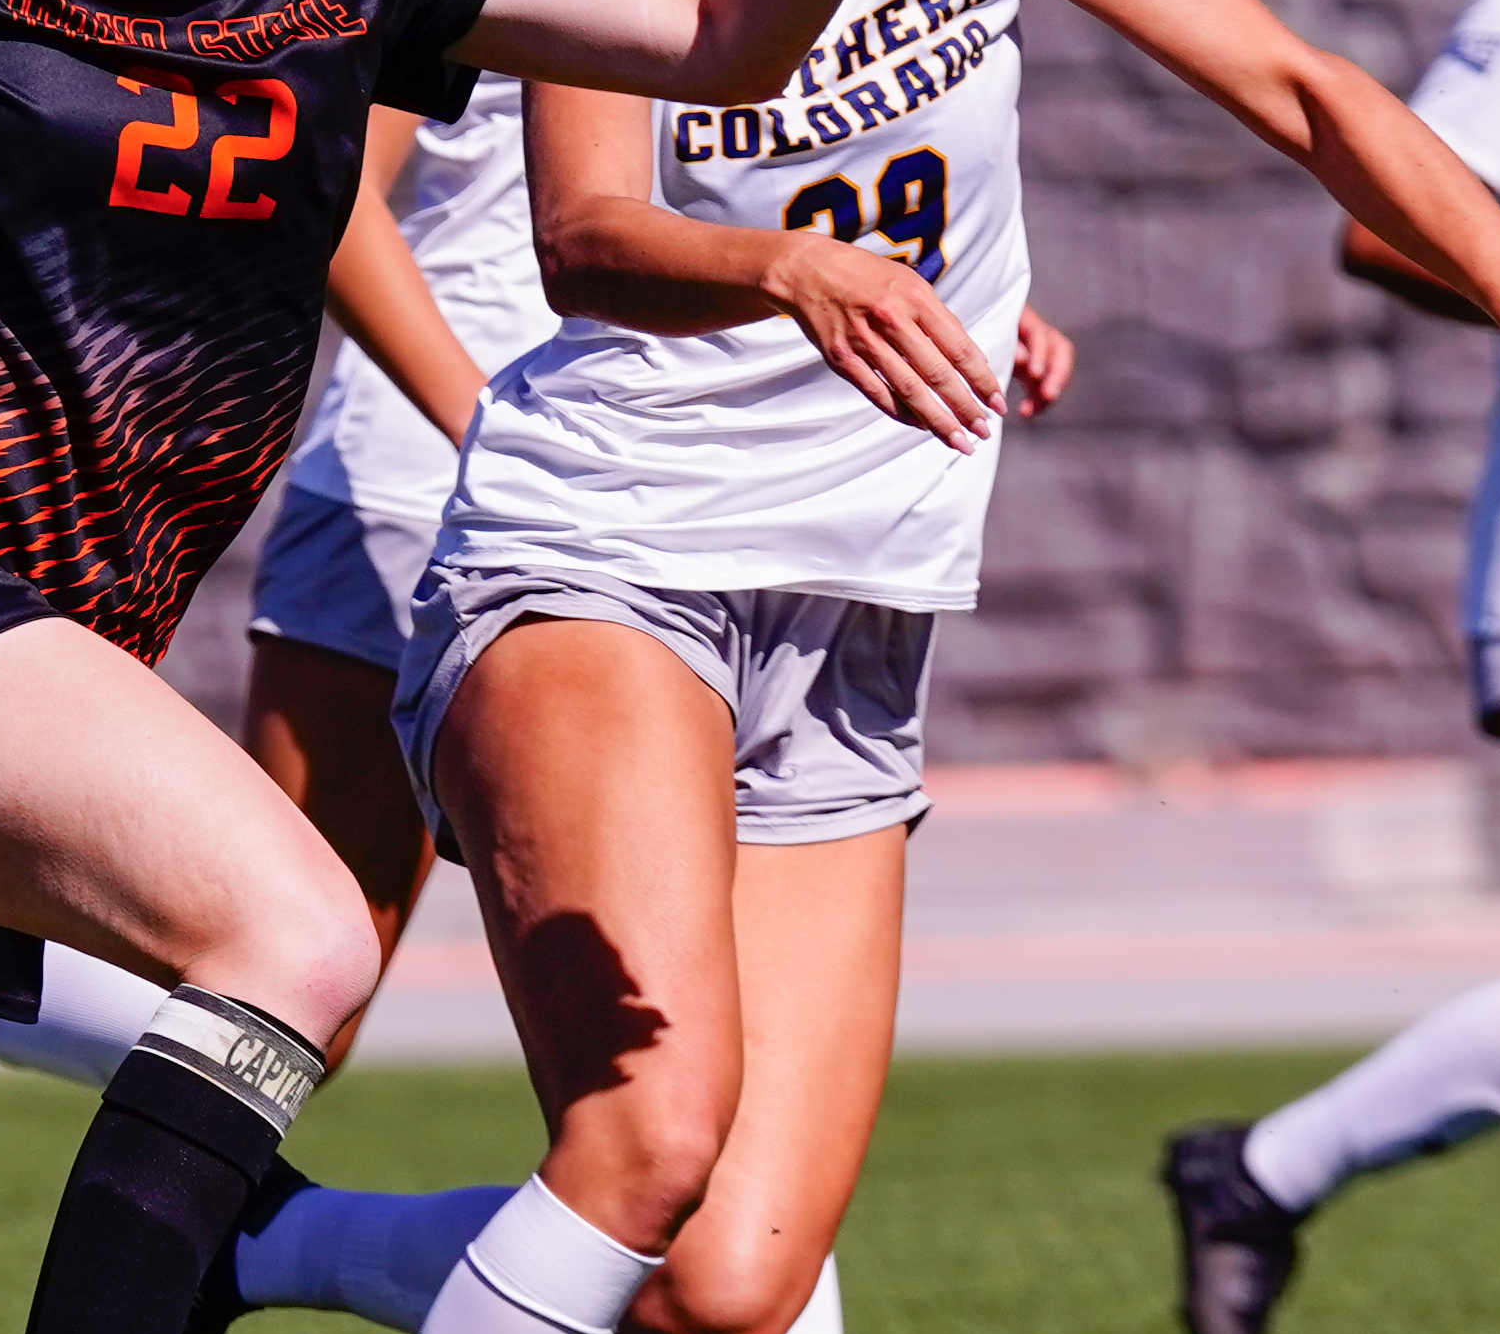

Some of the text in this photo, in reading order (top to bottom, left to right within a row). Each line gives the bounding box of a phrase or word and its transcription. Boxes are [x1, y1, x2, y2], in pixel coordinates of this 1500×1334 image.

[107, 67, 298, 221] 22
[673, 20, 990, 165] COLORADO
[224, 1027, 315, 1123] CAPTA
